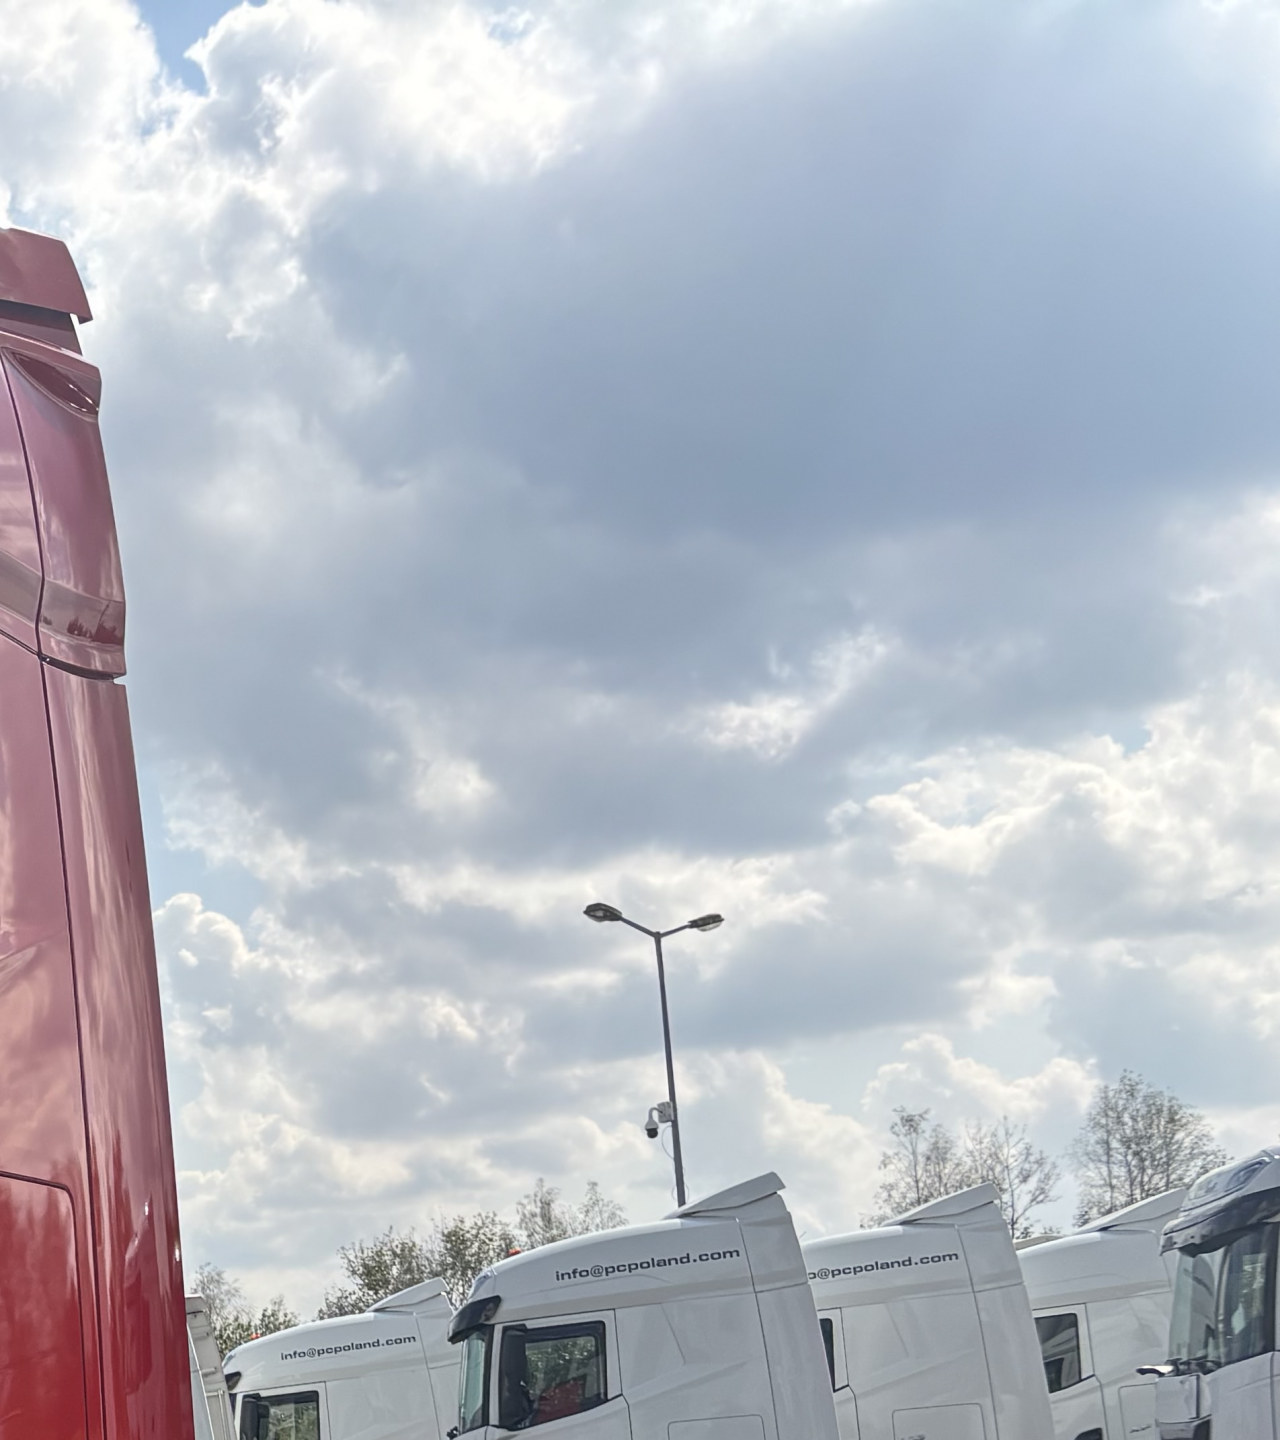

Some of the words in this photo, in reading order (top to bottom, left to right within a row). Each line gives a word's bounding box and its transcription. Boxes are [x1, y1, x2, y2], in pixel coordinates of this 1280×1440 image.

[555, 1249, 740, 1282] info@pcpoland.com
[808, 1253, 959, 1281] o@pcpoland.com
[280, 1335, 417, 1361] info@pcpoland.com
